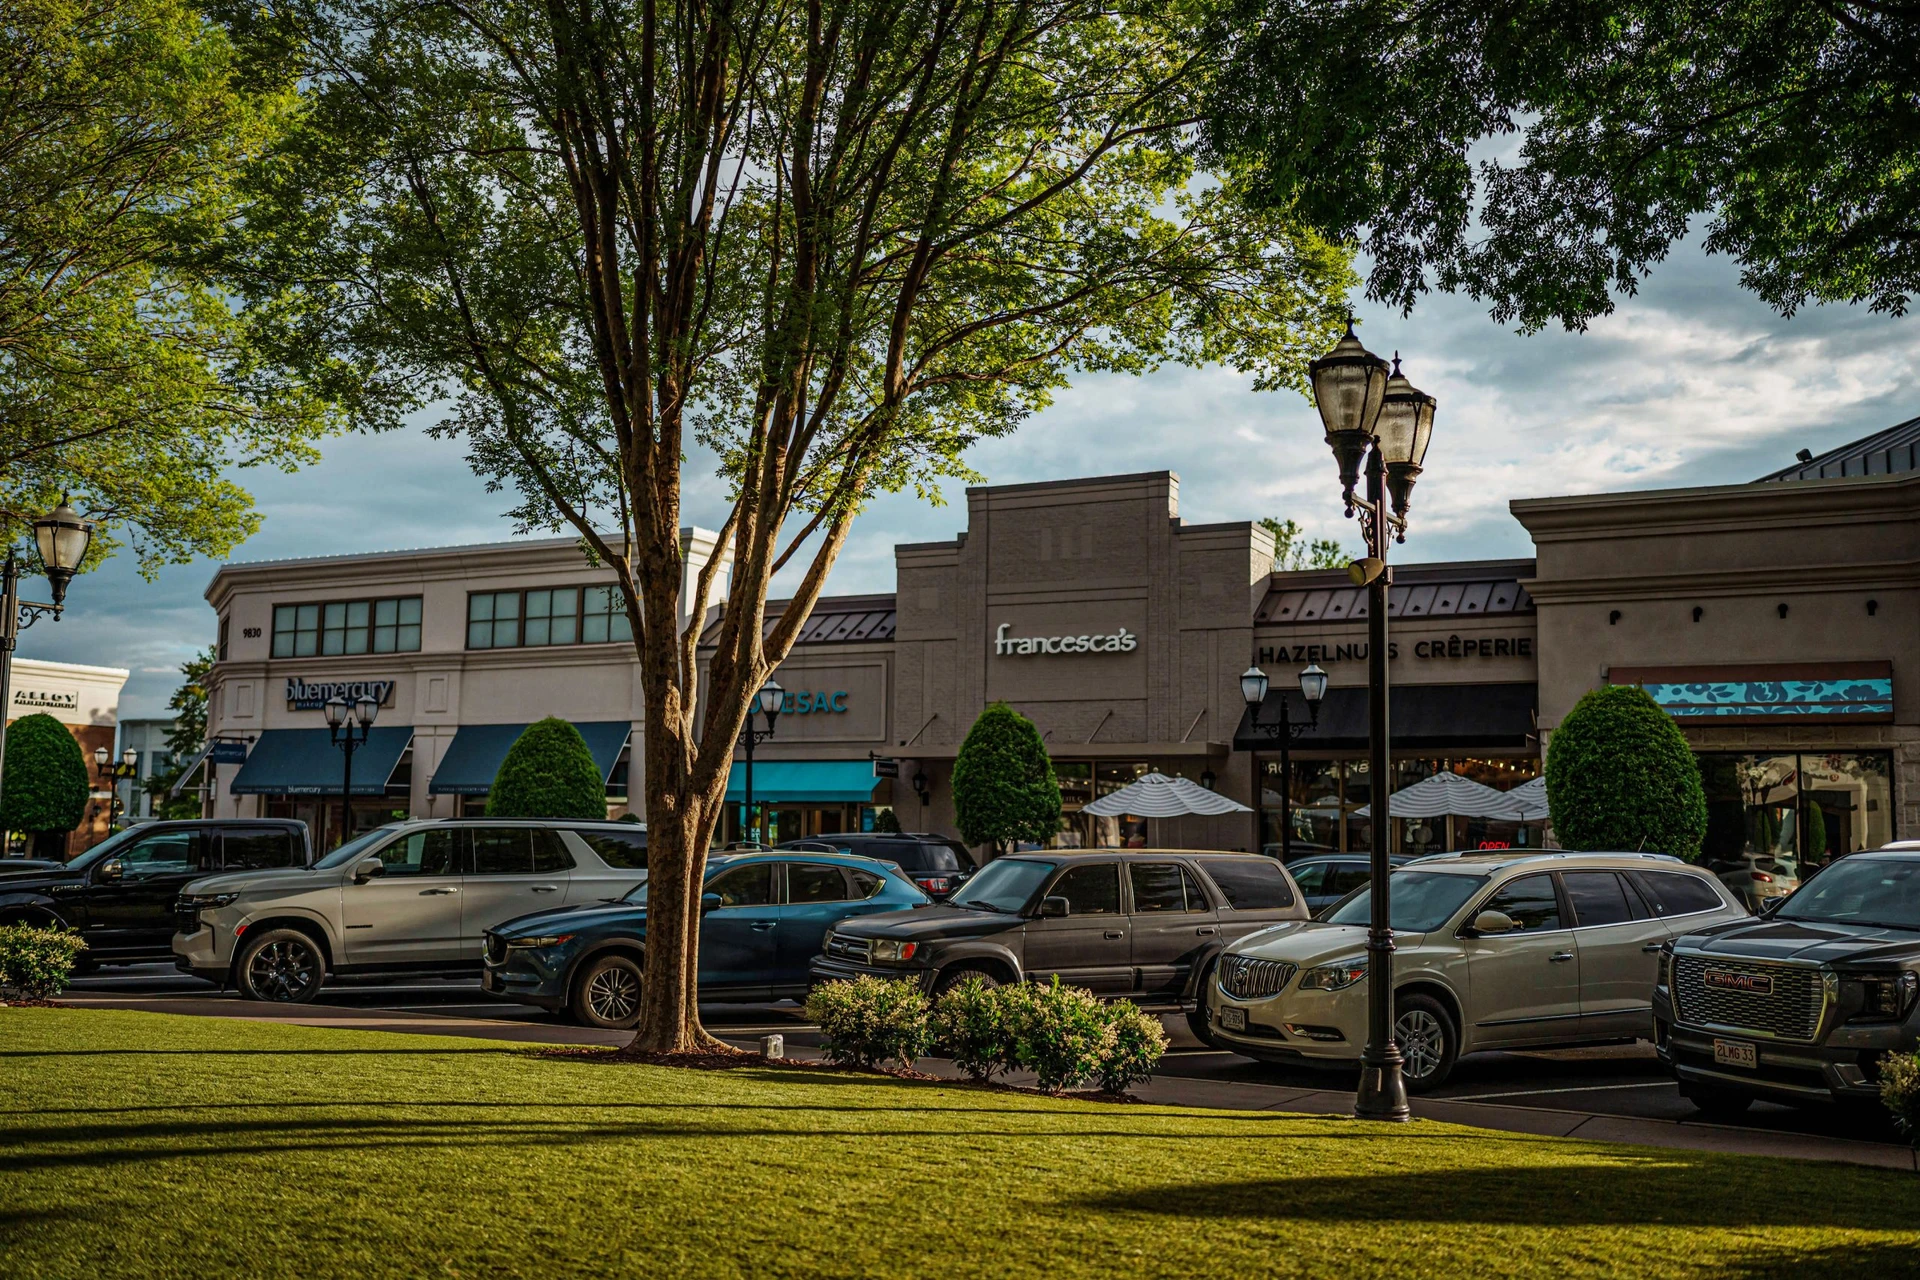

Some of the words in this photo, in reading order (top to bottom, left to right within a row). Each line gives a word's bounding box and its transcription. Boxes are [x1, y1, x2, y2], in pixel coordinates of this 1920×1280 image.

[243, 628, 262, 639] 9830
[995, 623, 1137, 655] francesca's
[1259, 643, 1399, 664] HAZELNUS
[1415, 635, 1532, 659] CRÊPERIE
[15, 690, 75, 703] ALLOY
[286, 678, 393, 705] bluemercury
[288, 785, 321, 795] bluemercury
[1479, 841, 1511, 850] OPEN
[1705, 971, 1770, 992] GMC
[1742, 1048, 1754, 1062] 33
